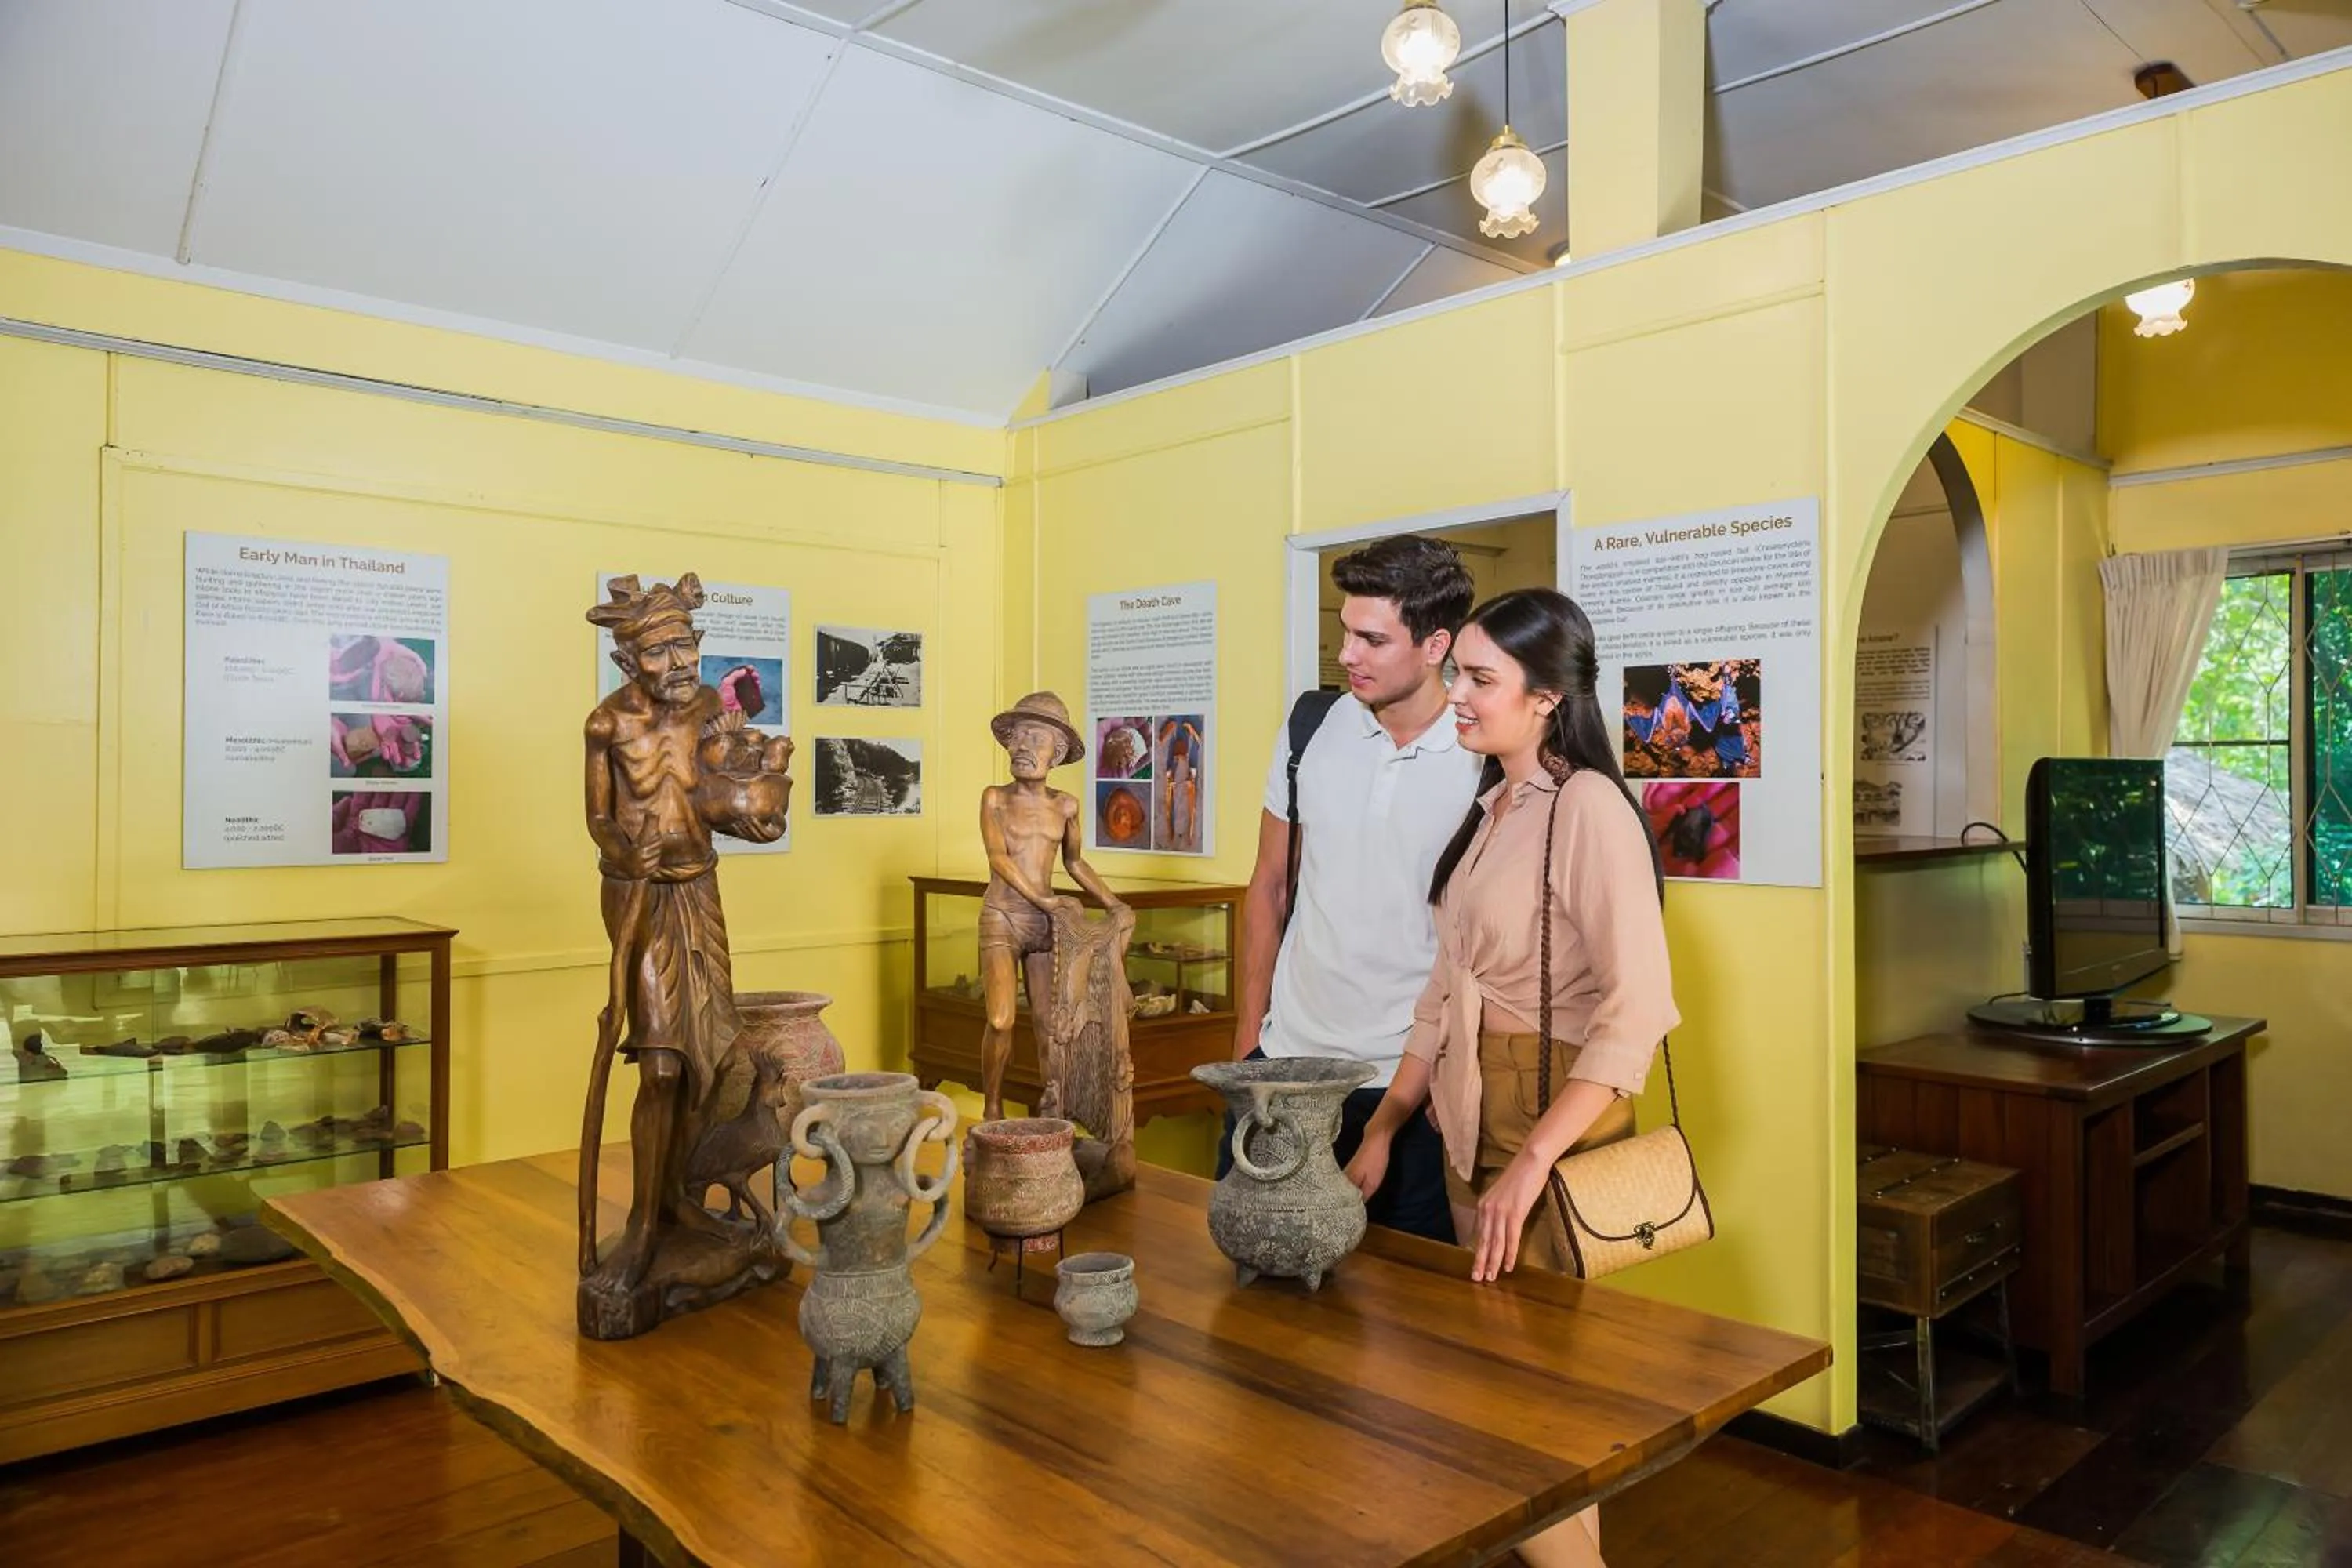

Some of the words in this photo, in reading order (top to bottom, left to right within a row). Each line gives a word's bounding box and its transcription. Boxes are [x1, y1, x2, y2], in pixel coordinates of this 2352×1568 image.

[1594, 539, 1603, 551] A
[1606, 536, 1642, 550] Rare,
[1646, 524, 1727, 546] Vulnerable
[1731, 515, 1793, 537] Species
[239, 546, 281, 565] Early
[285, 551, 318, 567] Man
[321, 554, 335, 568] in
[338, 556, 405, 574] Thailand
[711, 592, 753, 606] Culture
[1120, 600, 1134, 610] The
